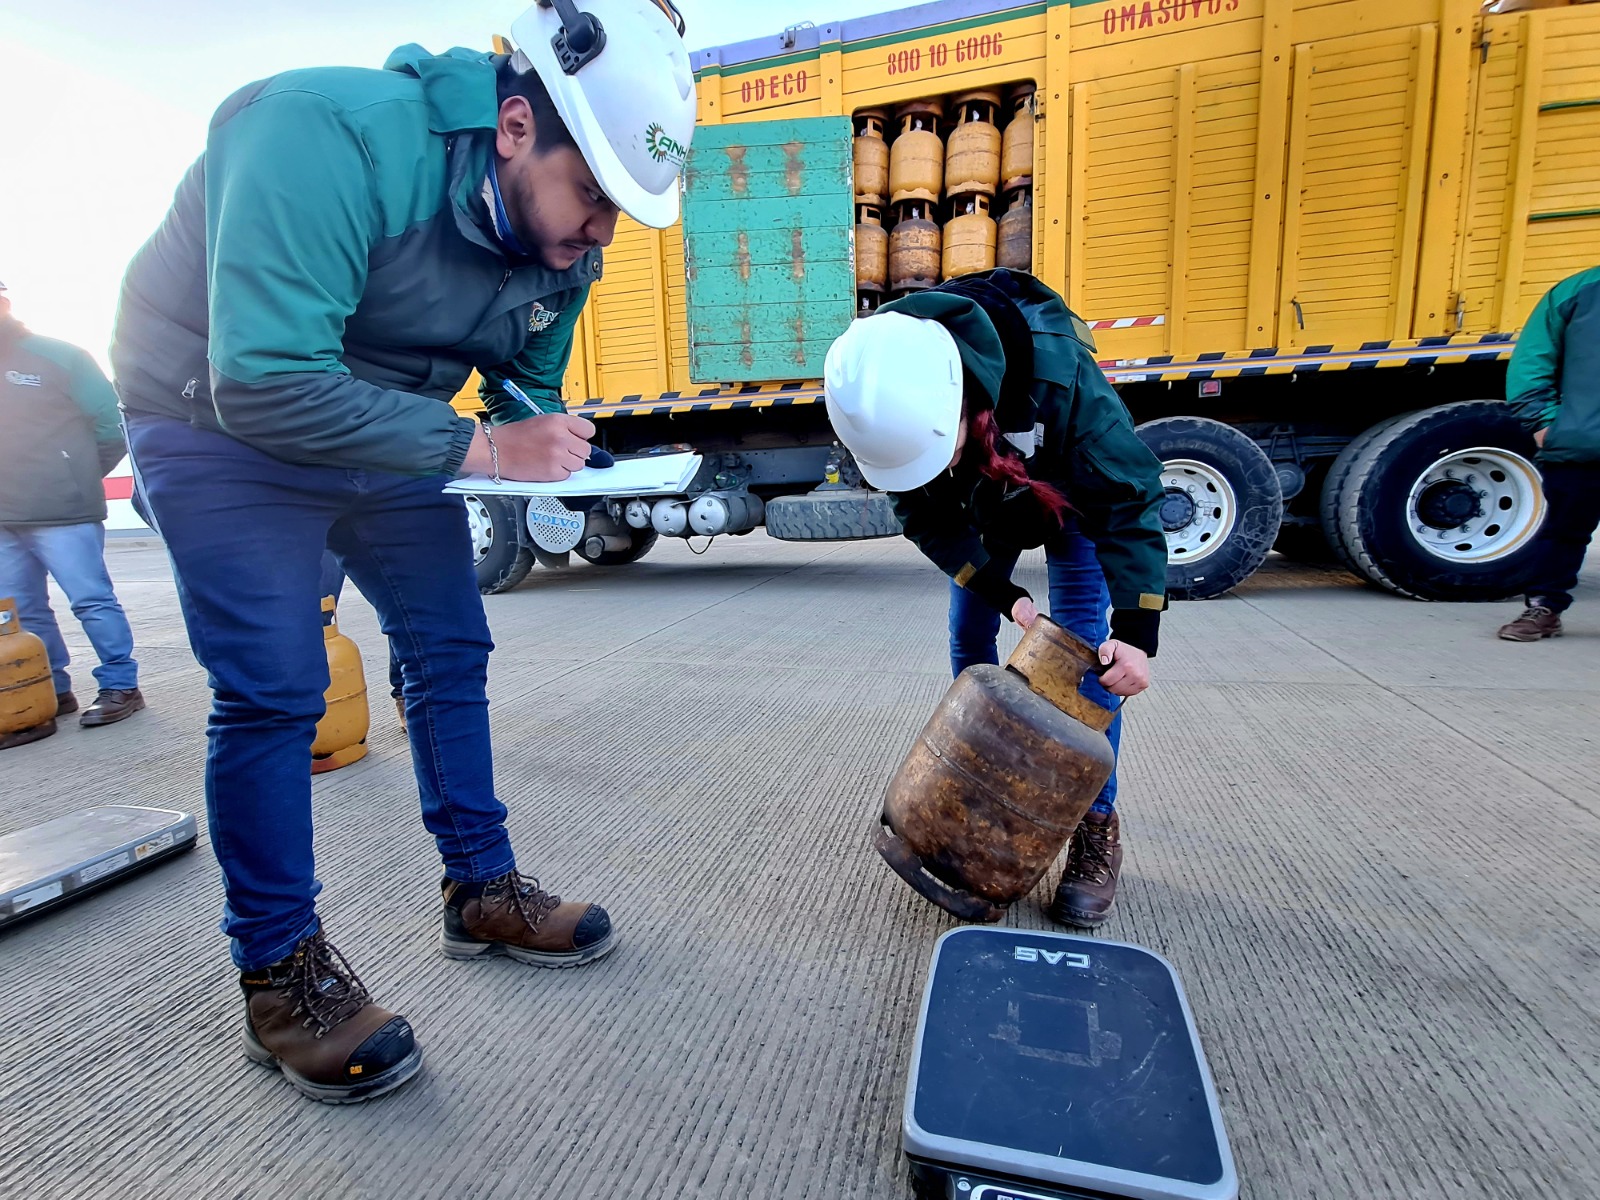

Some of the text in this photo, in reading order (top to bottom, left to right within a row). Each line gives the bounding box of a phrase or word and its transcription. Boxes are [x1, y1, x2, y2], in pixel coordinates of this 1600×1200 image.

[887, 32, 1003, 76] 800 10 6006
[741, 70, 807, 103] ODECO
[530, 512, 580, 529] VOLVO
[1015, 945, 1091, 969] CAS
